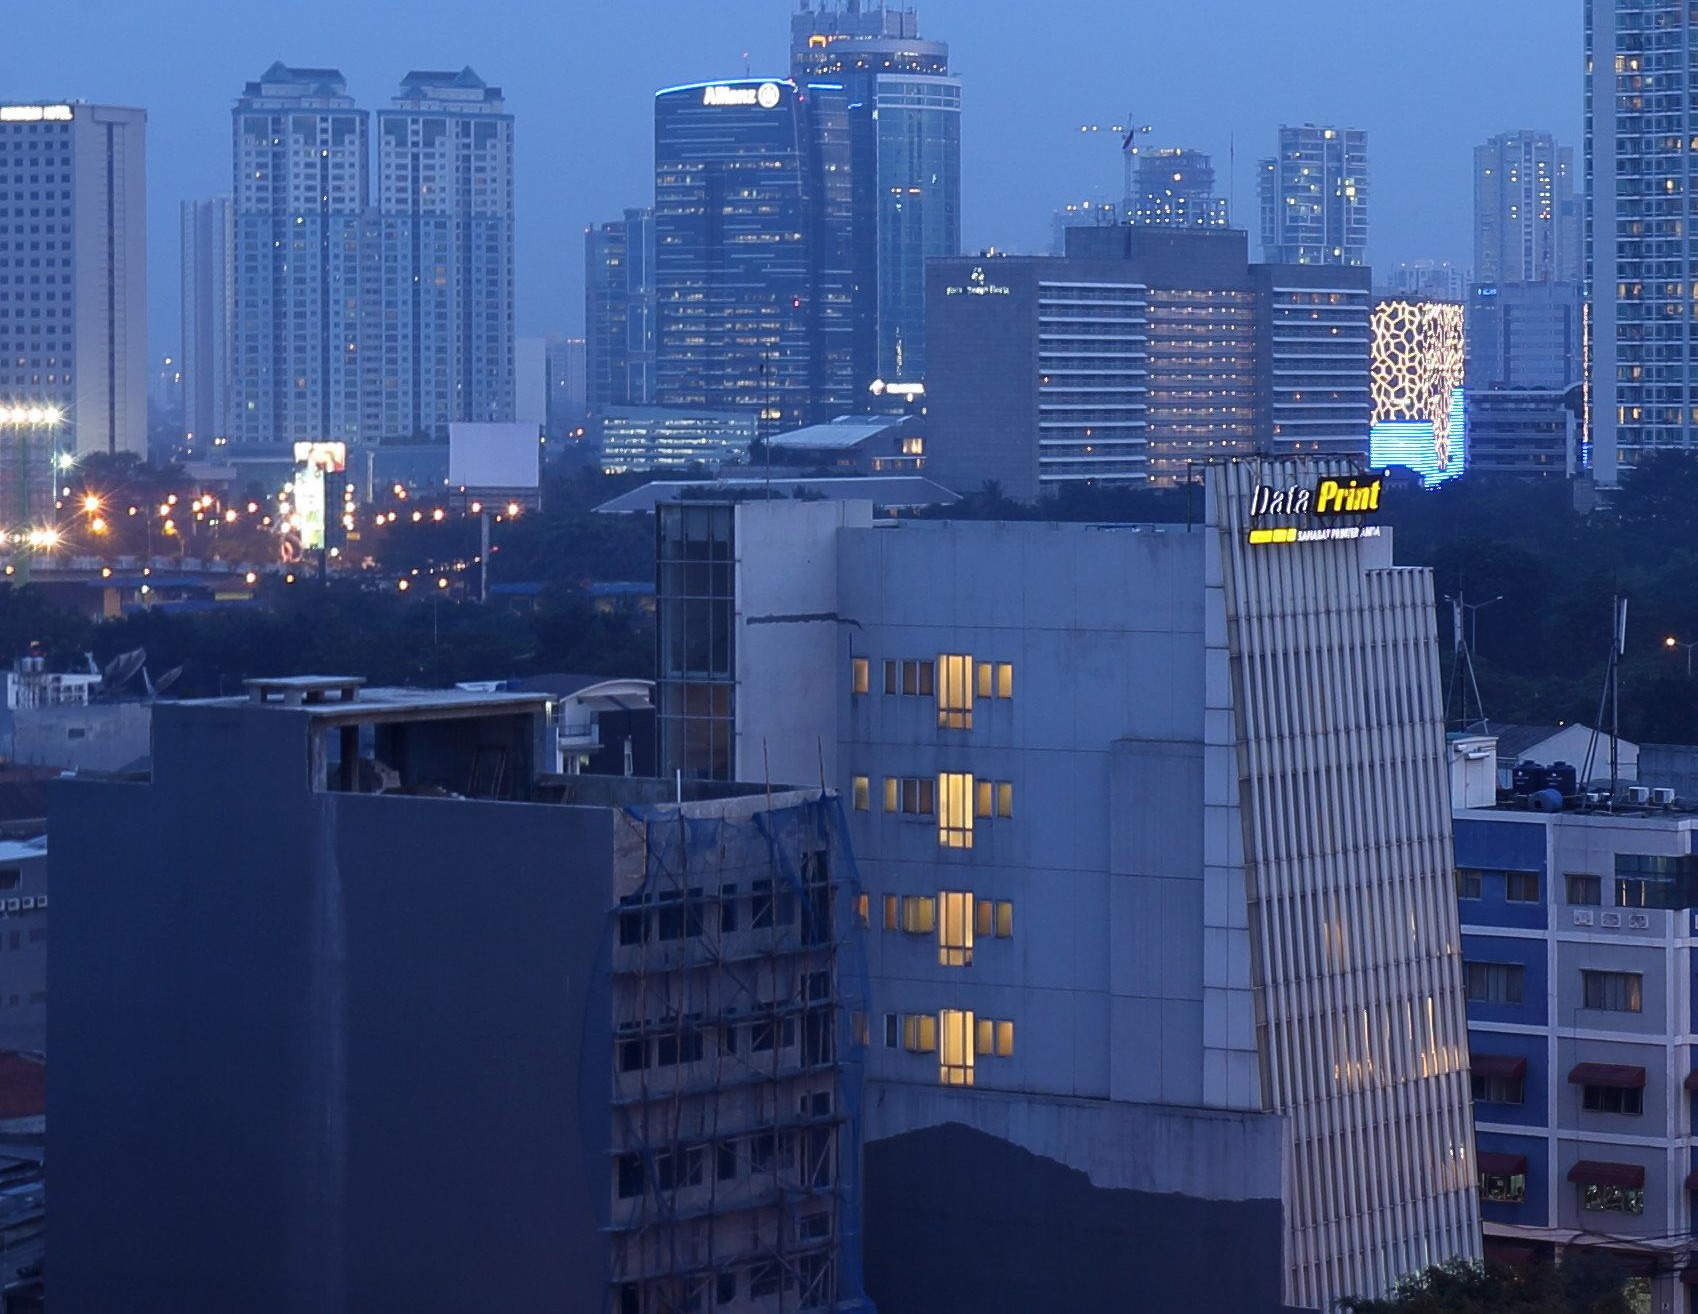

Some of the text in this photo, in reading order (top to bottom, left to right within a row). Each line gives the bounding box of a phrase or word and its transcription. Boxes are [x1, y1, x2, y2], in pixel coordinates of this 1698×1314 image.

[703, 85, 757, 105] Allianz
[1251, 480, 1381, 516] Data Print
